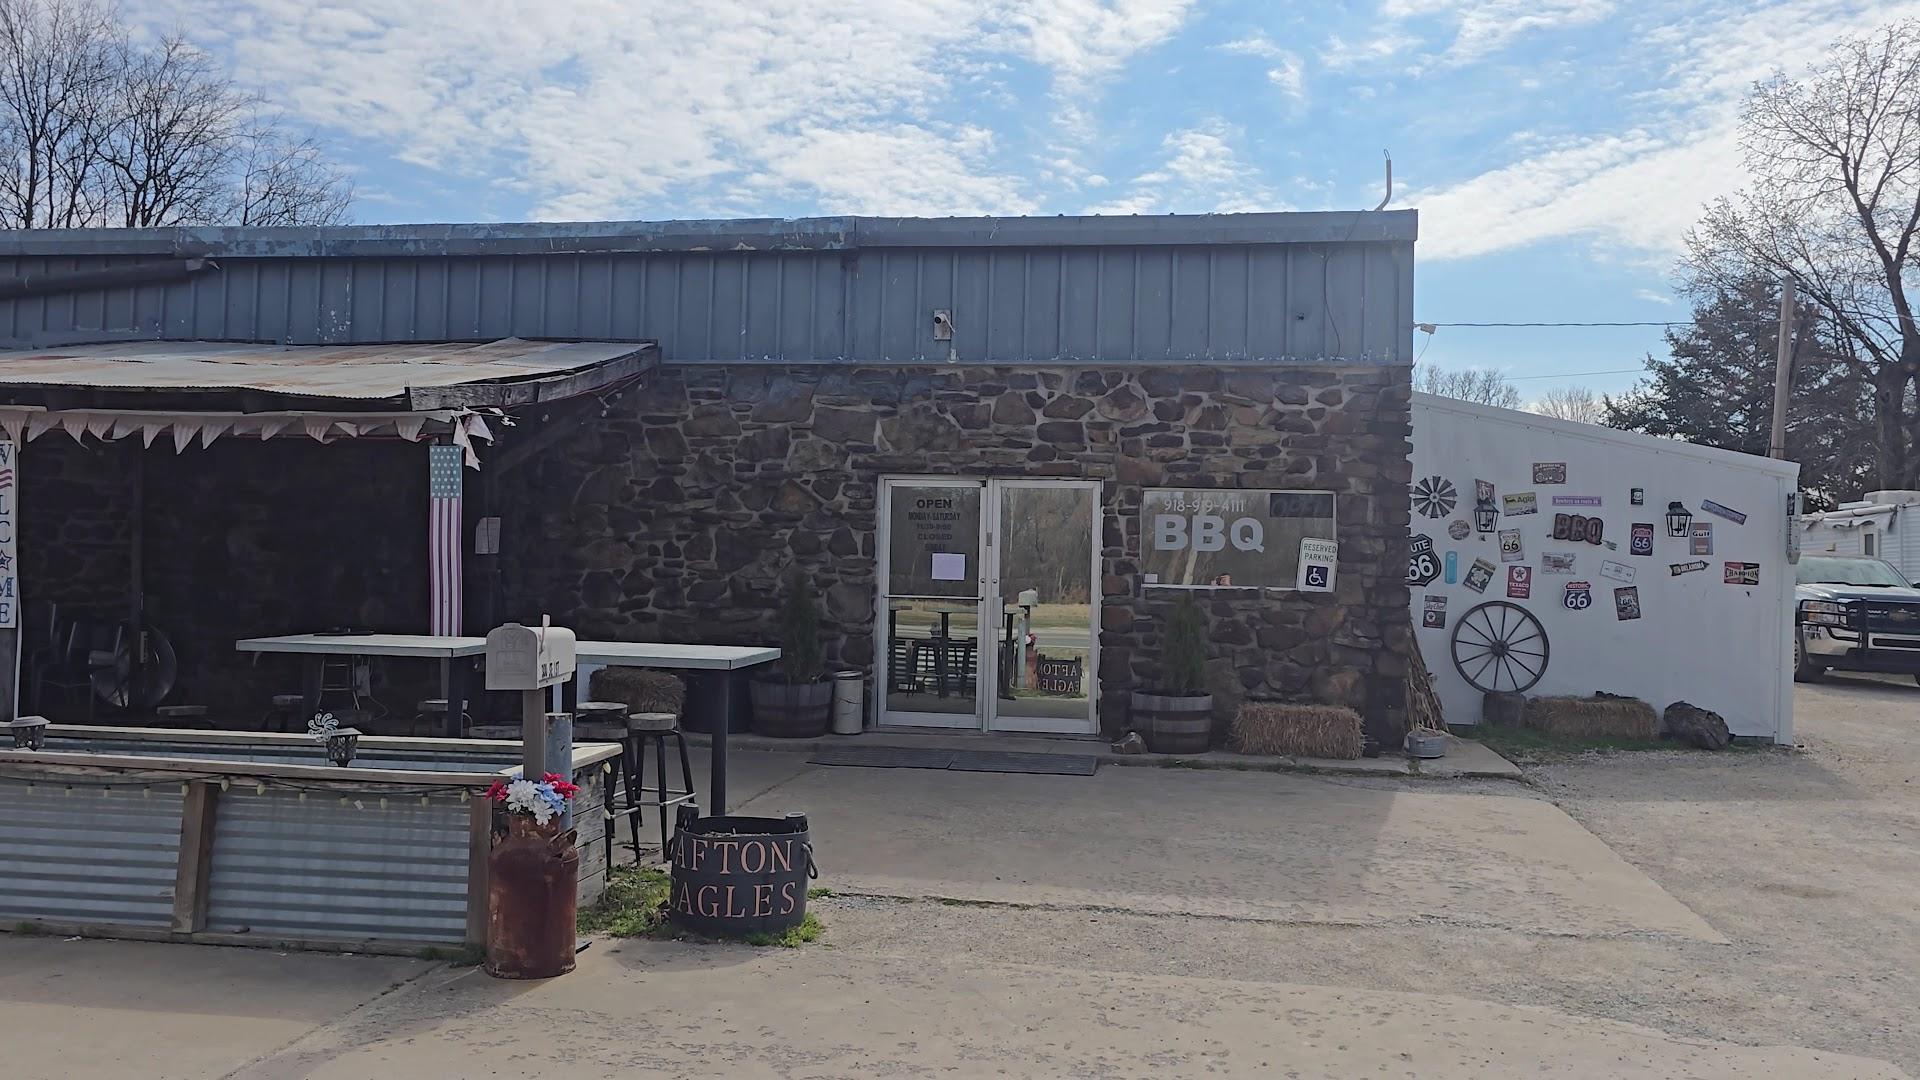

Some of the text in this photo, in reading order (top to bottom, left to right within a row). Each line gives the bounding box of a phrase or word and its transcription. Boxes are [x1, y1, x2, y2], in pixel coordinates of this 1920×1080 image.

[916, 499, 952, 508] OPEN
[1155, 514, 1264, 553] BBQ
[1553, 513, 1603, 545] BBQ
[1410, 540, 1430, 552] UTE
[1503, 540, 1519, 551] 66
[1634, 537, 1649, 548] 66
[1303, 543, 1337, 555] RESERVED
[1304, 552, 1335, 563] PARKING
[1408, 554, 1434, 580] 66
[1725, 567, 1759, 579] CHAMPION
[1566, 593, 1588, 608] 66
[675, 835, 793, 874] AFTON
[671, 877, 796, 918] AGLES
